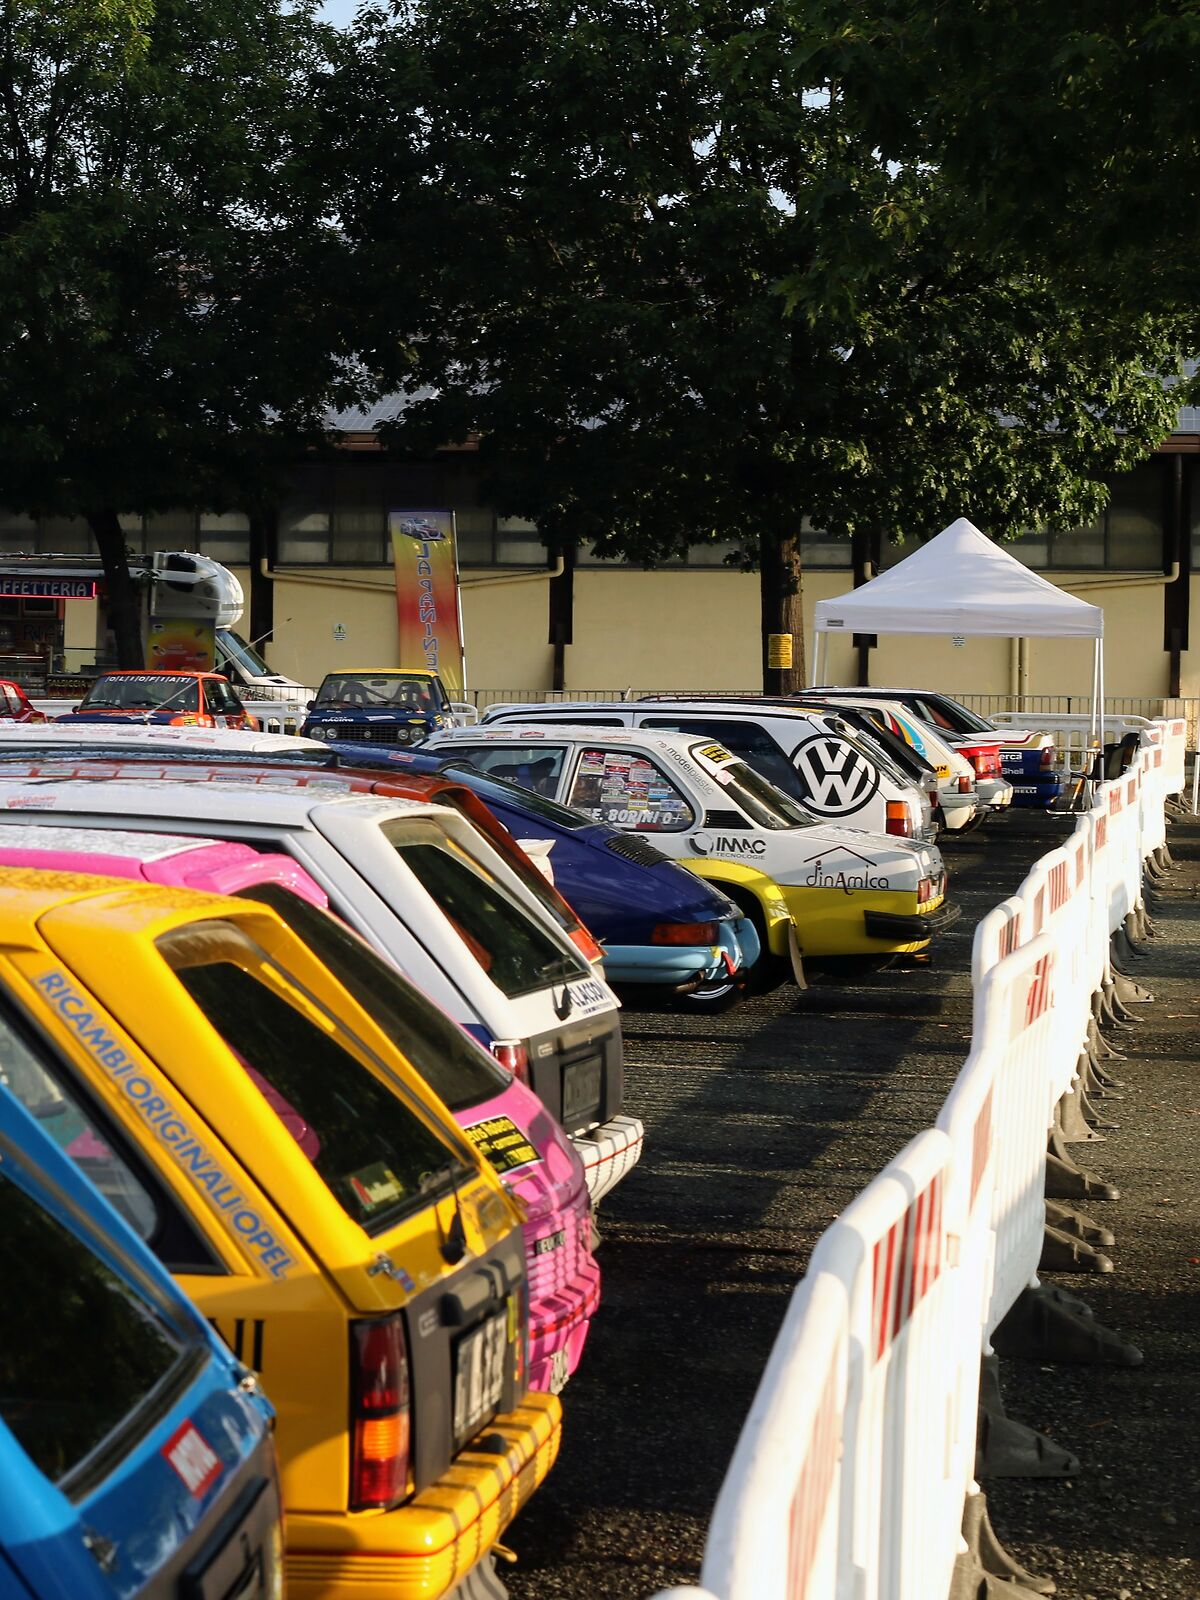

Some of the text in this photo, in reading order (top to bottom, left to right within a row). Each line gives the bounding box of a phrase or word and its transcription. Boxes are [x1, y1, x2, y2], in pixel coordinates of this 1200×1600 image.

[790, 734, 879, 816] VW
[715, 852, 766, 860] TECNOLOGIE
[39, 972, 134, 1077] RICAMBI
[125, 1076, 242, 1210] ORIGINALI
[232, 1210, 292, 1279] OPEL
